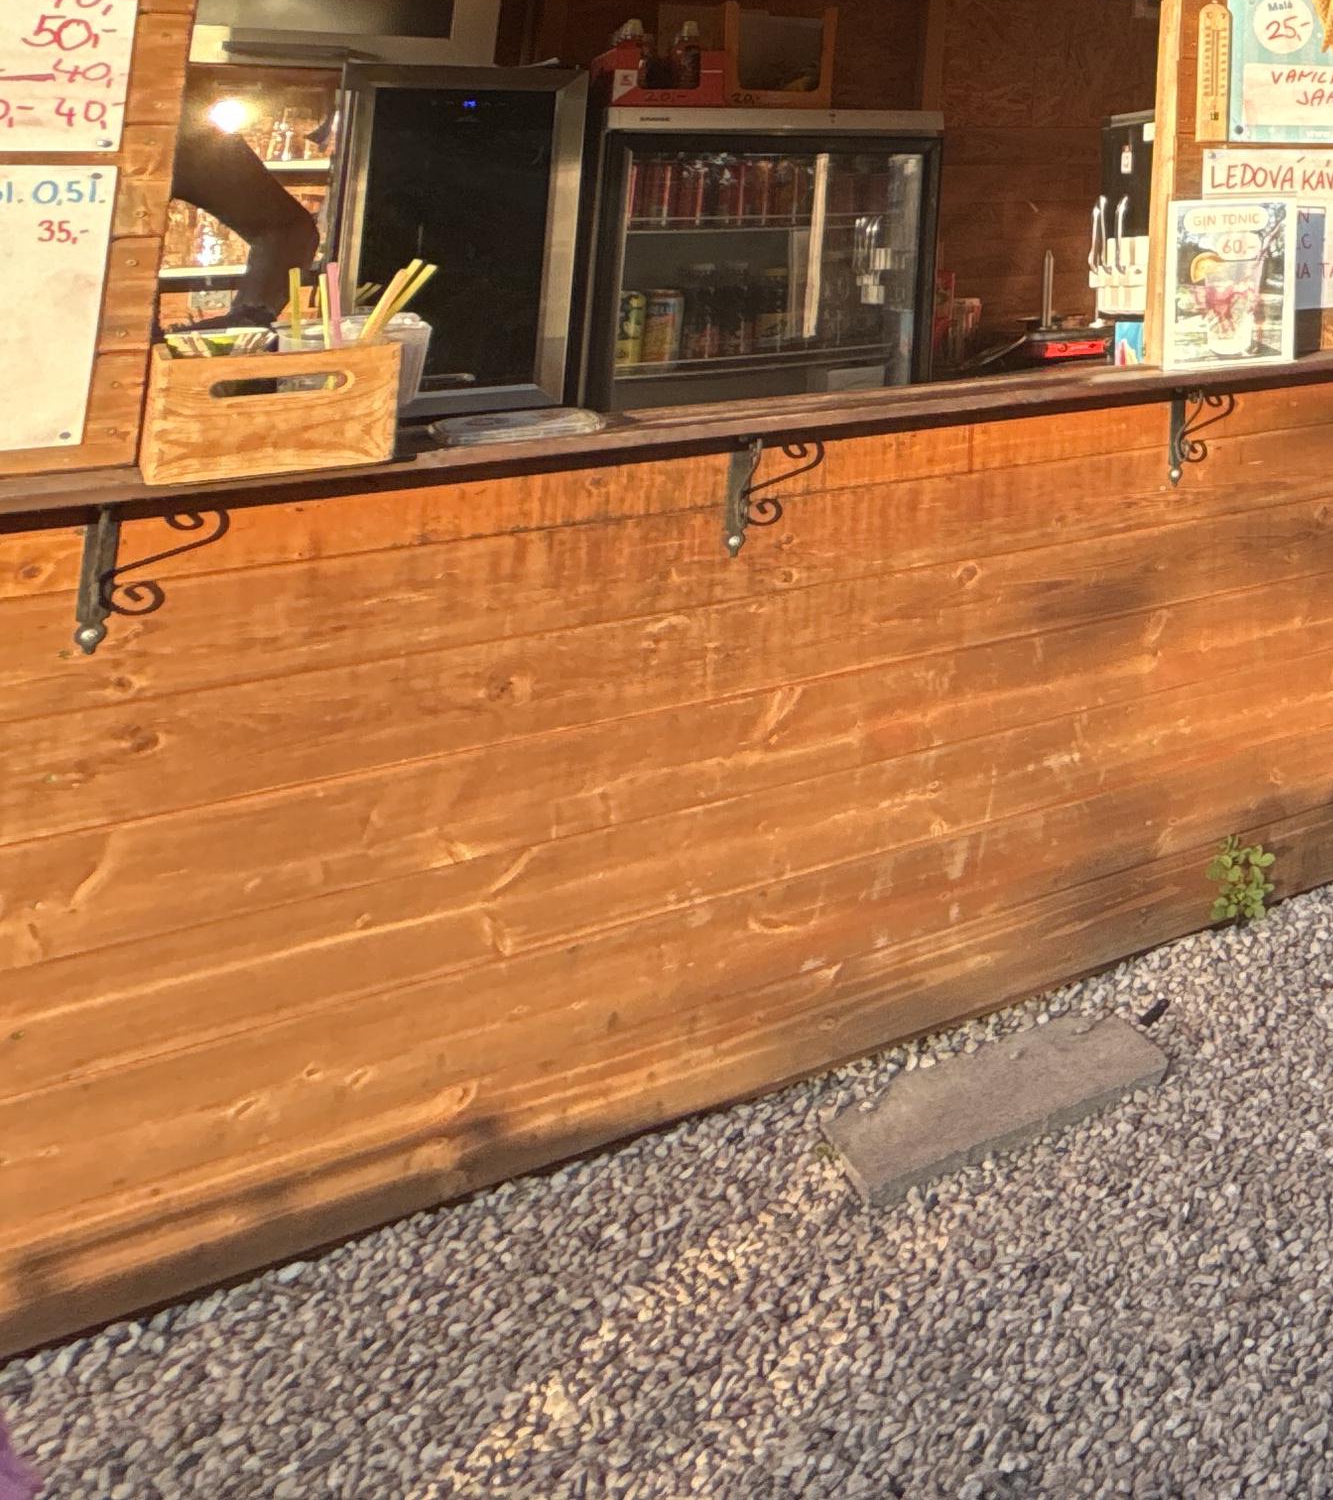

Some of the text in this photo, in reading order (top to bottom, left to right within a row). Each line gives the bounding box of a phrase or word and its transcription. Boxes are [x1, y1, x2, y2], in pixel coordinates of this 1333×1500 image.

[1267, 1, 1293, 12] Malá
[1265, 16, 1311, 42] 25,-
[1210, 156, 1305, 189] LEDOVÁ
[37, 219, 89, 245] 35,-
[1193, 212, 1260, 228] GIN TONIC
